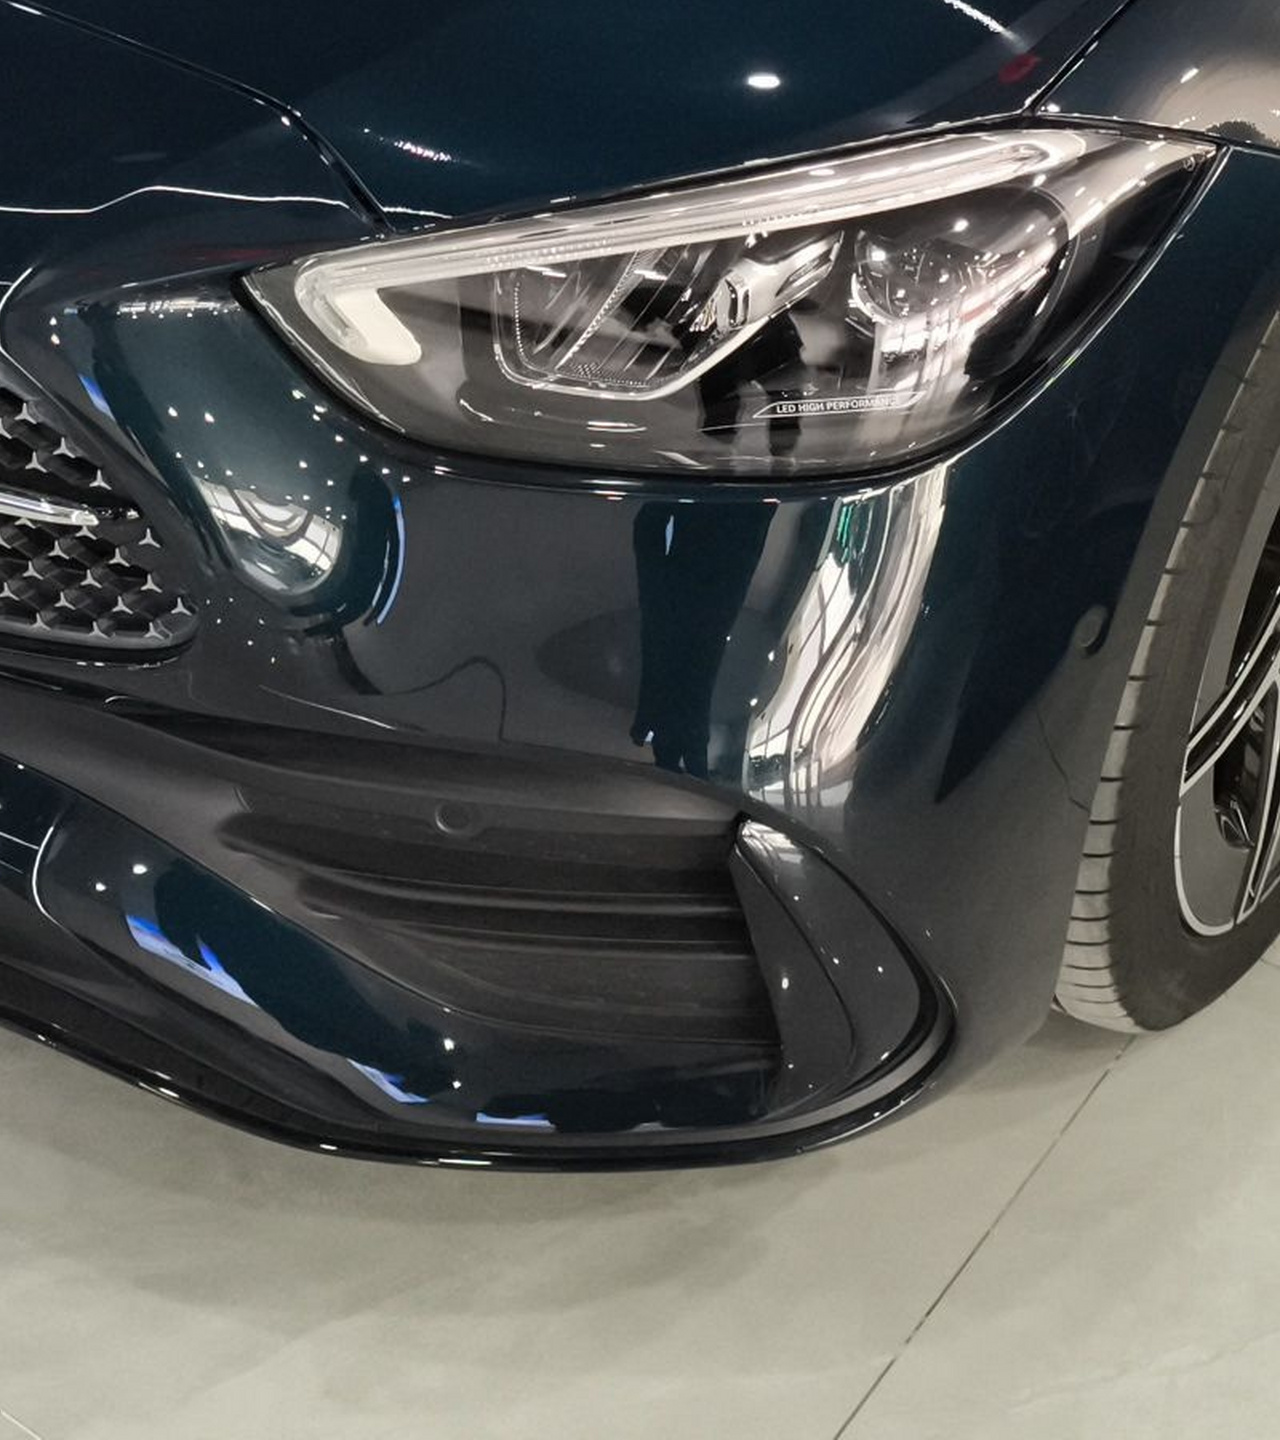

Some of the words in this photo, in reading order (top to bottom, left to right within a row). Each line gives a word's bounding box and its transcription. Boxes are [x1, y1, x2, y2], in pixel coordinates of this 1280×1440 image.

[776, 404, 796, 414] LED
[798, 402, 825, 413] HIGH
[826, 396, 902, 411] PERFORMANC
